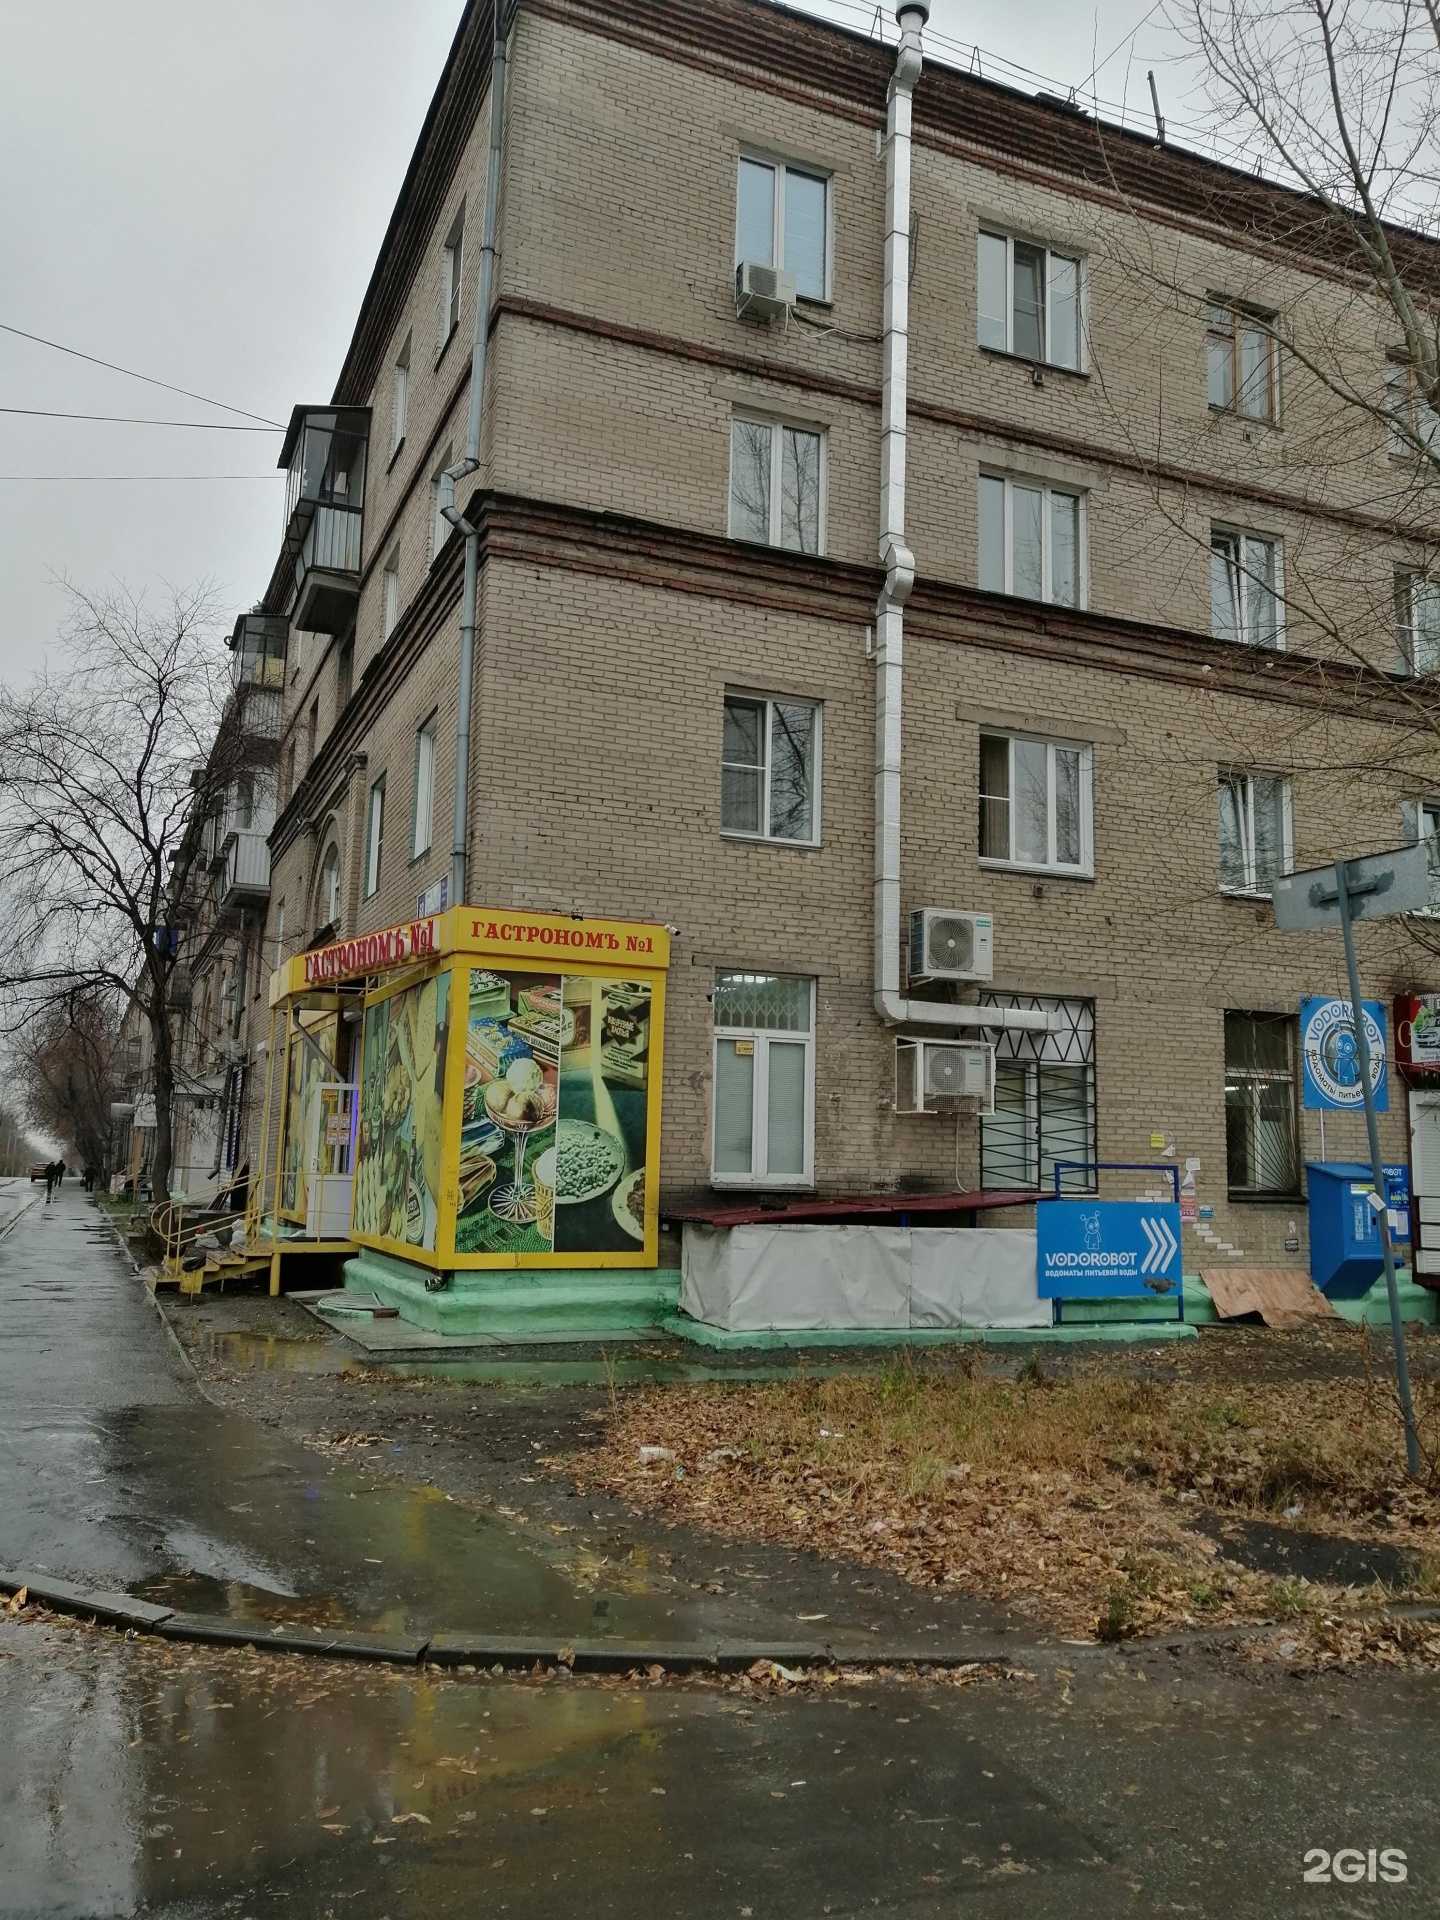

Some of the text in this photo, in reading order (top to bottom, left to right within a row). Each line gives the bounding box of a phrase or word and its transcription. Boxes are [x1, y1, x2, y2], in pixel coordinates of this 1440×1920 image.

[471, 921, 654, 953] ГАСТРОНОМЪ №1
[304, 928, 405, 983] ГАСТРОНОМЪ
[1045, 1252, 1138, 1266] VODOROBOT
